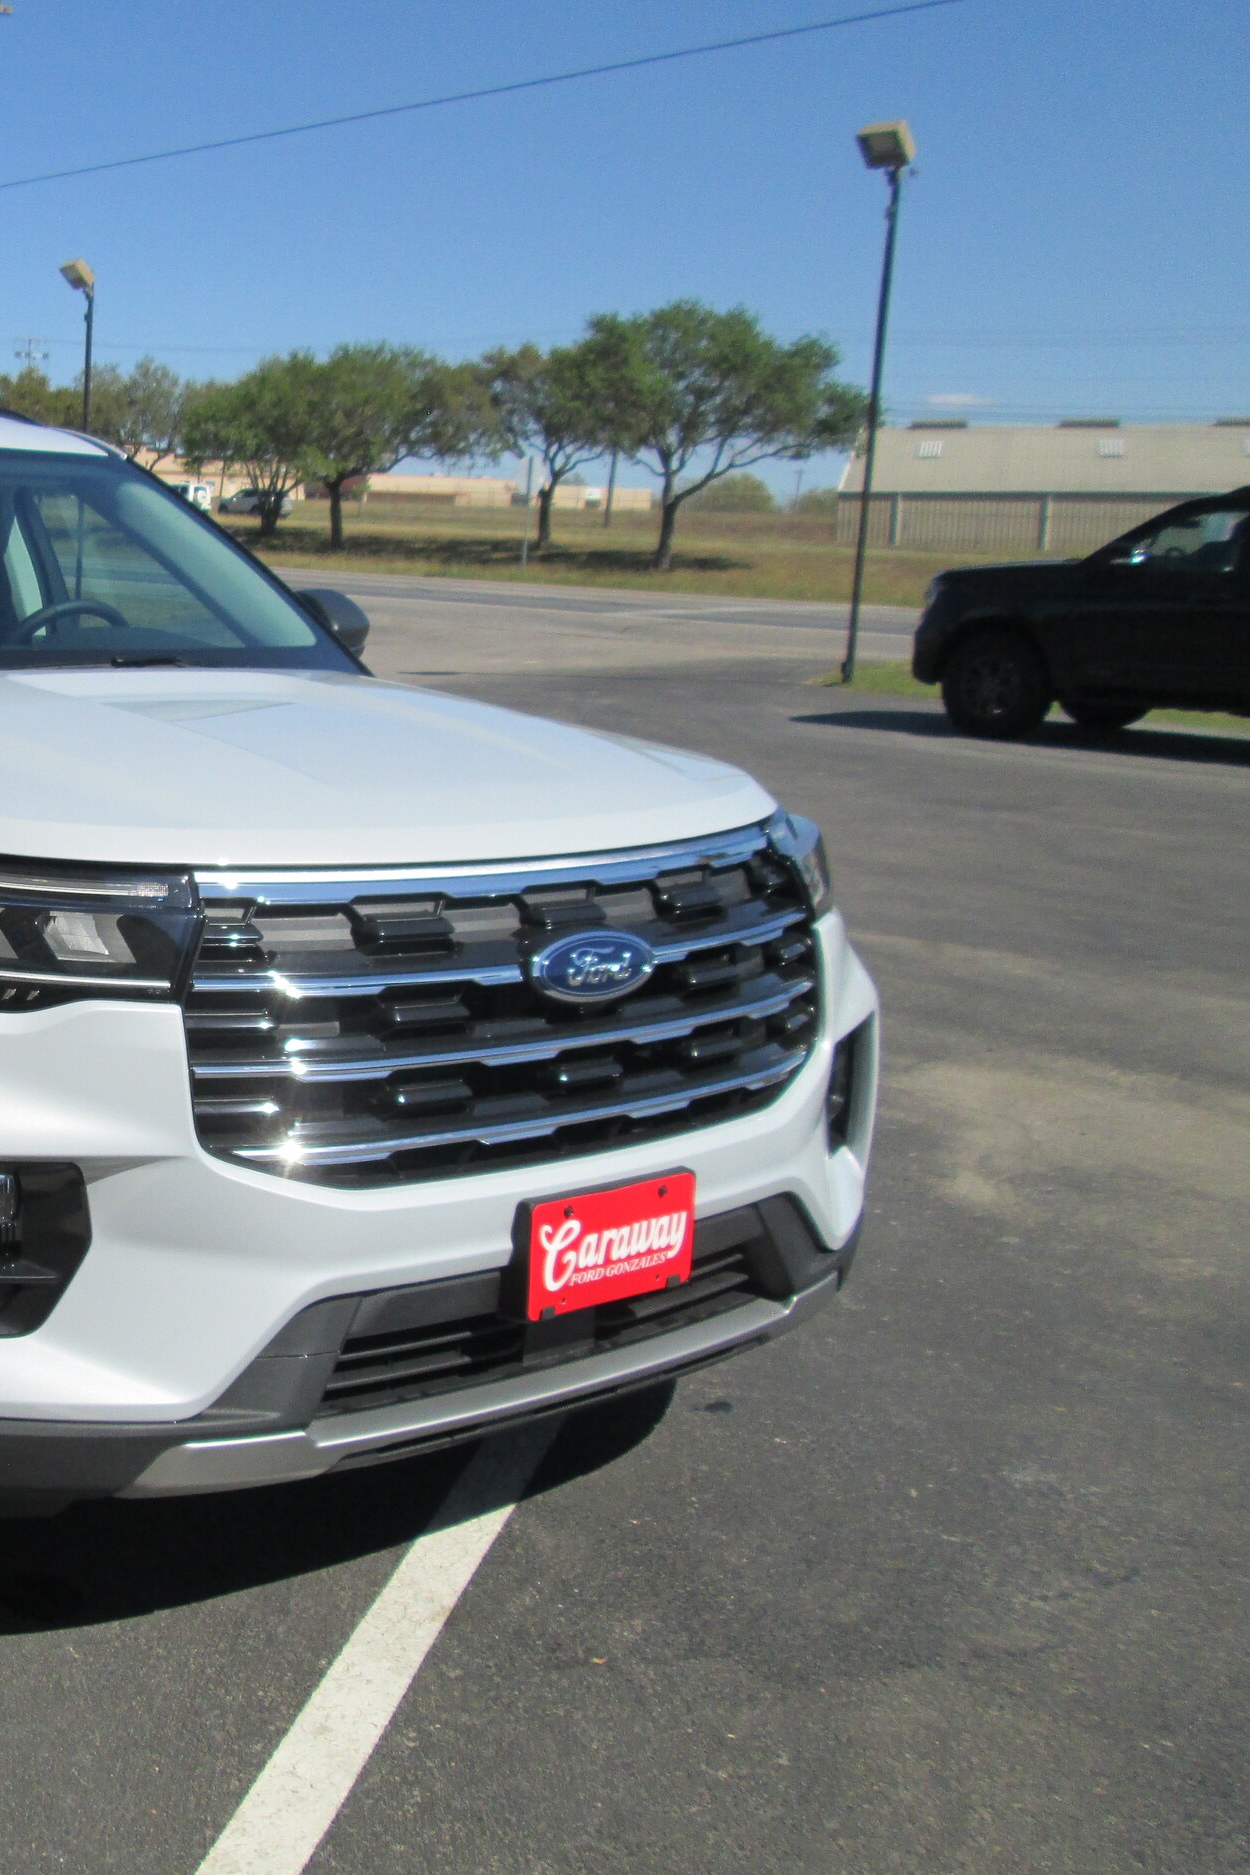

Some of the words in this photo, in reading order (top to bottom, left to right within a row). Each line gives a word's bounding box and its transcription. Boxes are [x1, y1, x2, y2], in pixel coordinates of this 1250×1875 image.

[567, 945, 632, 987] Ford
[539, 1210, 688, 1292] Caraway
[569, 1268, 605, 1287] FORD
[606, 1252, 668, 1277] GONZALES
